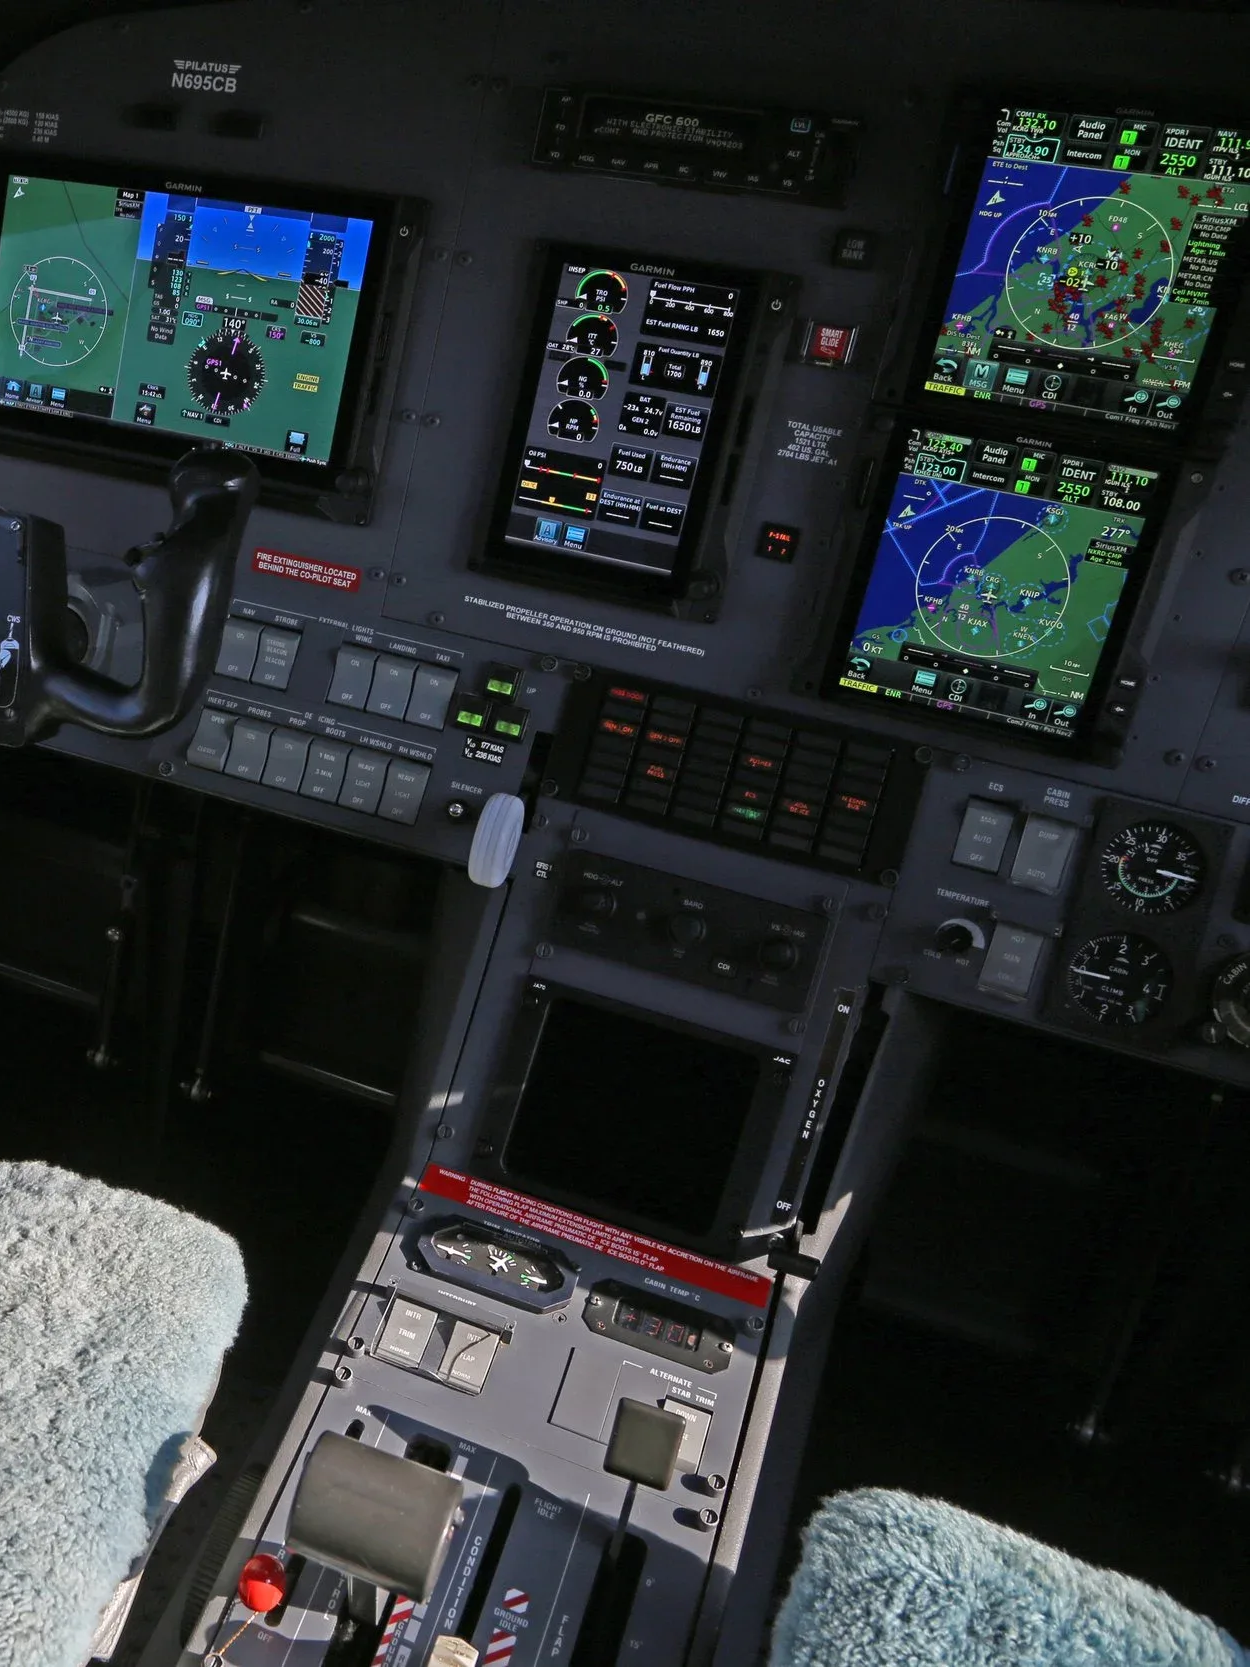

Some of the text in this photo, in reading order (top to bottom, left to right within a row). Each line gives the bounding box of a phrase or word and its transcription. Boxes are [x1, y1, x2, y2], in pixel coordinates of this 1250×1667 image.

[185, 60, 228, 73] PILATUS
[171, 72, 237, 93] N695CB
[645, 112, 699, 127] GFC 600
[1016, 110, 1035, 118] COM1
[1017, 118, 1057, 130] 132.10
[1079, 119, 1106, 131] Audio
[1077, 128, 1103, 140] Panel
[1165, 128, 1189, 136] XPDR1
[1011, 143, 1049, 157] 124.90
[1165, 137, 1203, 150] IDENT
[1067, 149, 1102, 160] Intercom
[1160, 153, 1197, 168] 2550
[1165, 167, 1183, 176] ALT
[165, 181, 202, 193] GARMIN
[123, 191, 134, 199] Map
[1070, 234, 1091, 244] +10
[568, 265, 586, 274] INSEP
[630, 262, 675, 277] GARMIN
[654, 281, 695, 294] Fuel Flow PPH
[646, 318, 725, 337] EST Fuel RMNG LB 1650
[820, 326, 843, 341] SMART
[819, 335, 840, 349] GLIDE
[666, 369, 682, 379] 1700
[668, 363, 681, 372] Total
[928, 382, 963, 395] TRAFFIC
[969, 378, 987, 388] MSG
[1002, 384, 1024, 395] Menu
[973, 390, 991, 400] ENR
[1042, 390, 1057, 400] CDI
[667, 419, 701, 434] 1650 LB
[787, 420, 842, 437] TOTAL USABLE
[794, 430, 831, 442] CAPACITY
[1017, 436, 1052, 448] GARMIN
[787, 443, 800, 452] 402
[815, 448, 829, 458] GAL
[812, 440, 827, 449] LTR
[983, 444, 1009, 457] Audio
[777, 449, 794, 459] 2704
[795, 452, 809, 461] LBS
[981, 454, 1006, 465] Panel
[615, 460, 643, 474] 750 LB
[1062, 458, 1084, 467] XPDR1
[921, 462, 956, 477] 123.00
[1061, 467, 1097, 482] IDENT
[972, 472, 1005, 483] Intercom
[1111, 471, 1149, 487] 111.10
[1057, 482, 1091, 497] 2550
[1062, 494, 1079, 504] ALT
[1102, 496, 1140, 512] 108.00
[564, 539, 583, 550] Menu
[256, 552, 357, 581] FIRE EXTINGUISHER LOCATED
[258, 561, 351, 588] BEHIND THE CO-PILOT SEAT
[7, 614, 21, 623] CWS
[275, 615, 298, 626] STROBE
[318, 616, 374, 636] EXTERNAL LIGHTS
[464, 595, 705, 657] STABILIZED PROPELLER OPERATION ON GROUND (NOT FEATHERED)
[506, 611, 656, 652] BETWEEN 350 AND 950 RPM IS PROHIBITED
[355, 634, 373, 644] WING
[389, 642, 417, 655] LANDING
[435, 653, 450, 663] TAXI
[843, 679, 876, 692] TRAFFIC
[911, 685, 933, 696] Menu
[885, 688, 901, 699] ENR
[451, 780, 483, 794] SILENCER
[988, 781, 1004, 792] ECS
[1046, 787, 1071, 800] CABIN
[1044, 795, 1070, 808] PRESS
[936, 887, 990, 908] TEMPERATURE
[837, 1003, 850, 1015] ON
[801, 1079, 825, 1140] OXYGEN
[776, 1199, 792, 1212] OFF
[644, 1277, 689, 1298] CABIN TEMP
[650, 1367, 693, 1389] ALTERNATE
[671, 1385, 715, 1407] STAB TRIM
[355, 1405, 372, 1417] MAX
[443, 1535, 483, 1630] CONDITION
[493, 1608, 530, 1628] GROUND
[499, 1619, 519, 1632] IDLE
